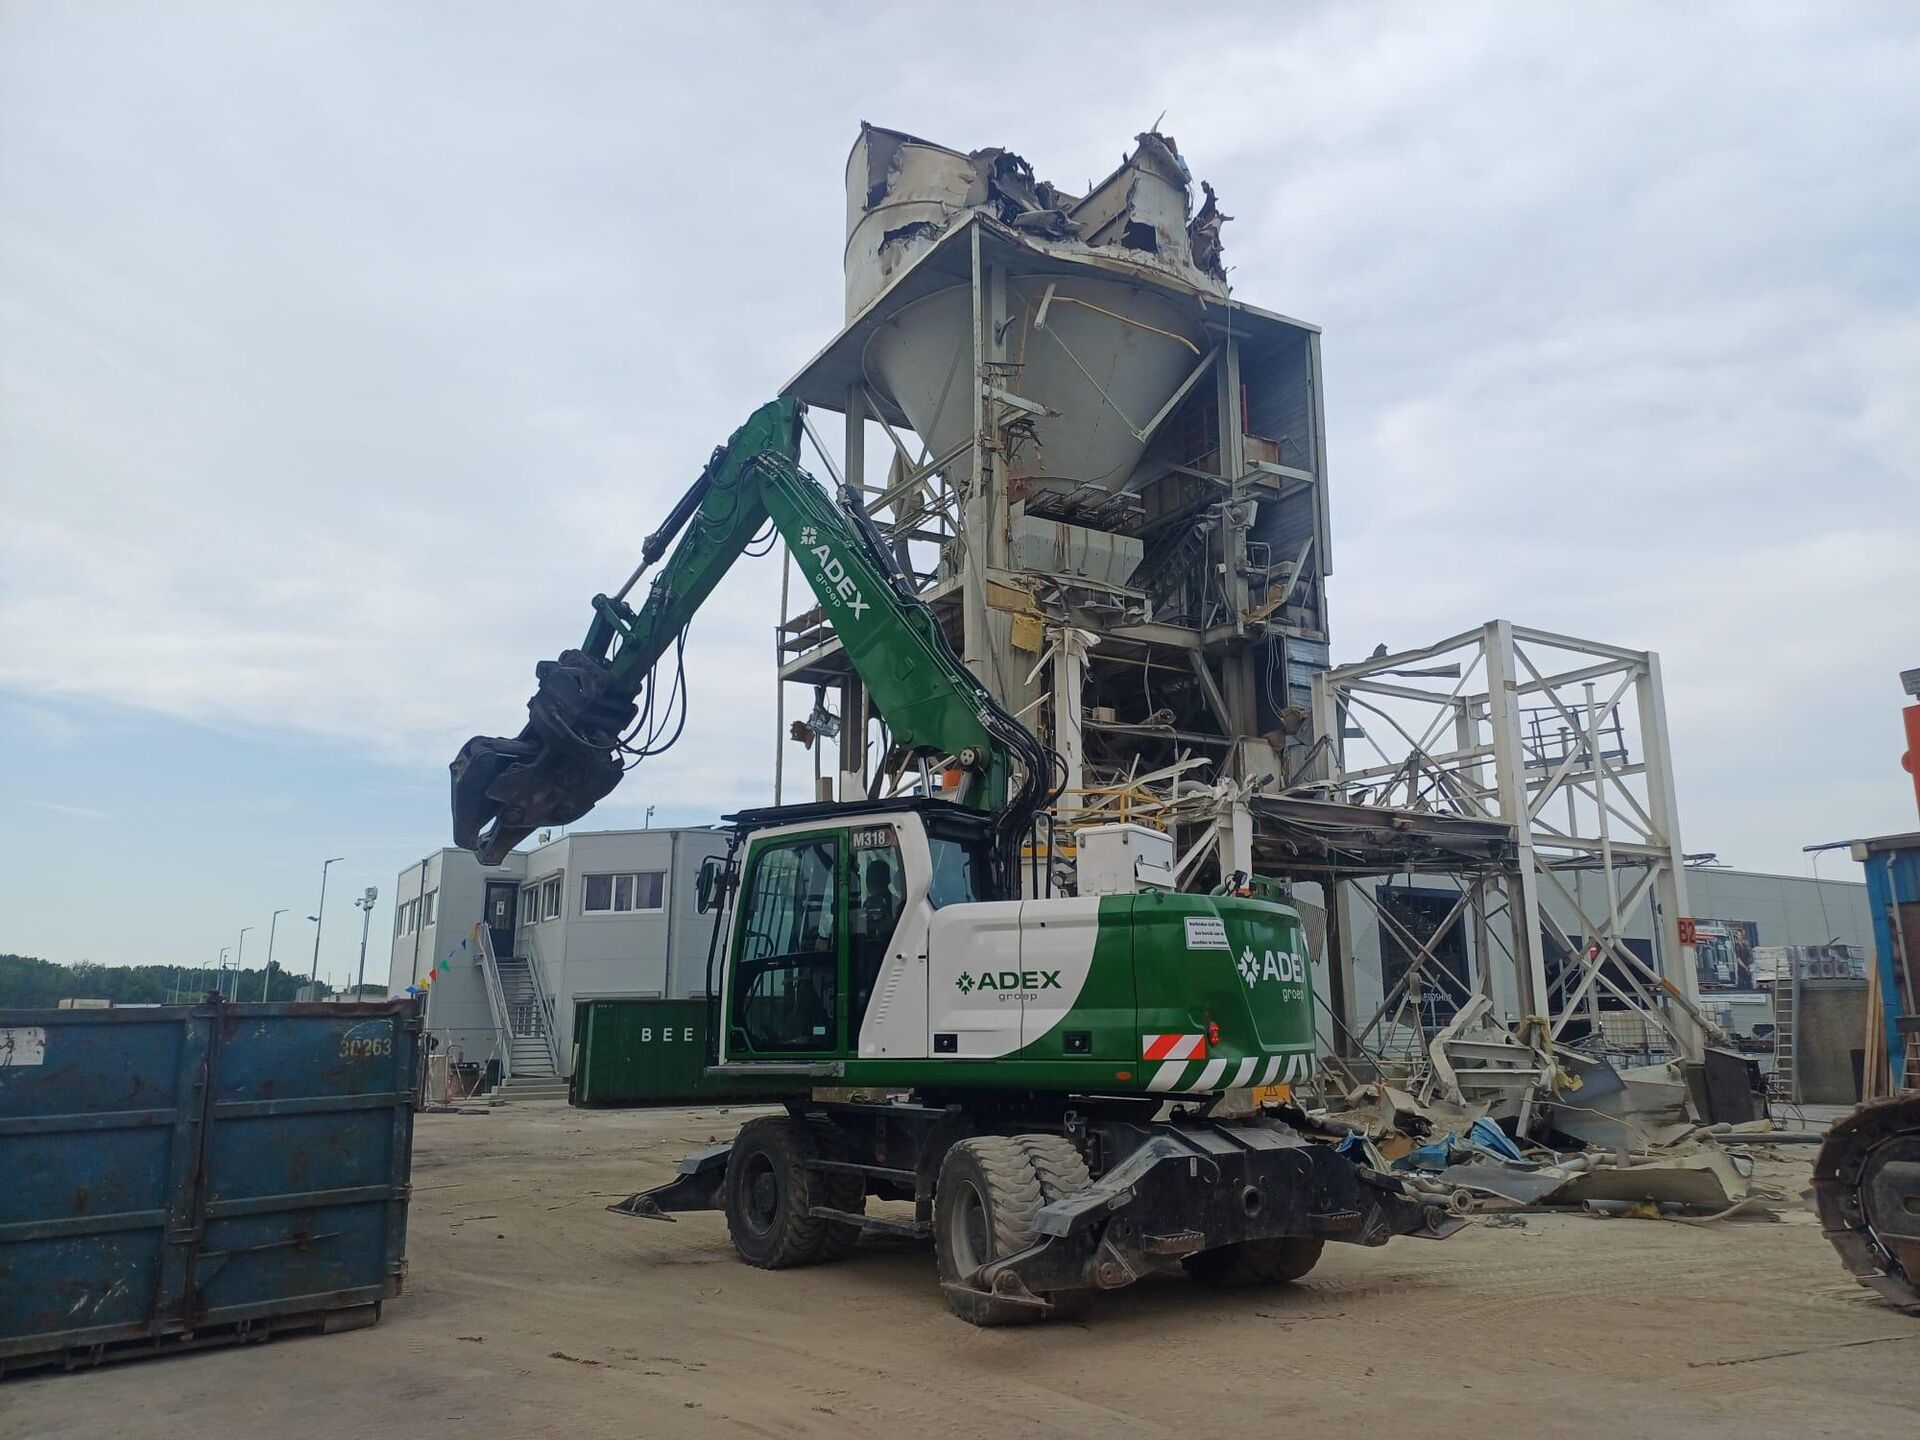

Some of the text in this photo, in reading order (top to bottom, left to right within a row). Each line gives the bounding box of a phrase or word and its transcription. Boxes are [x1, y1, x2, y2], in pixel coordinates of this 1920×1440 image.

[811, 545, 871, 621] ADEX
[815, 573, 841, 608] groep
[853, 831, 886, 848] M318
[1679, 920, 1696, 944] B2
[977, 971, 1062, 990] ADEX
[999, 993, 1038, 1002] groep
[641, 1027, 708, 1042] BEE
[339, 1038, 393, 1058] 30263
